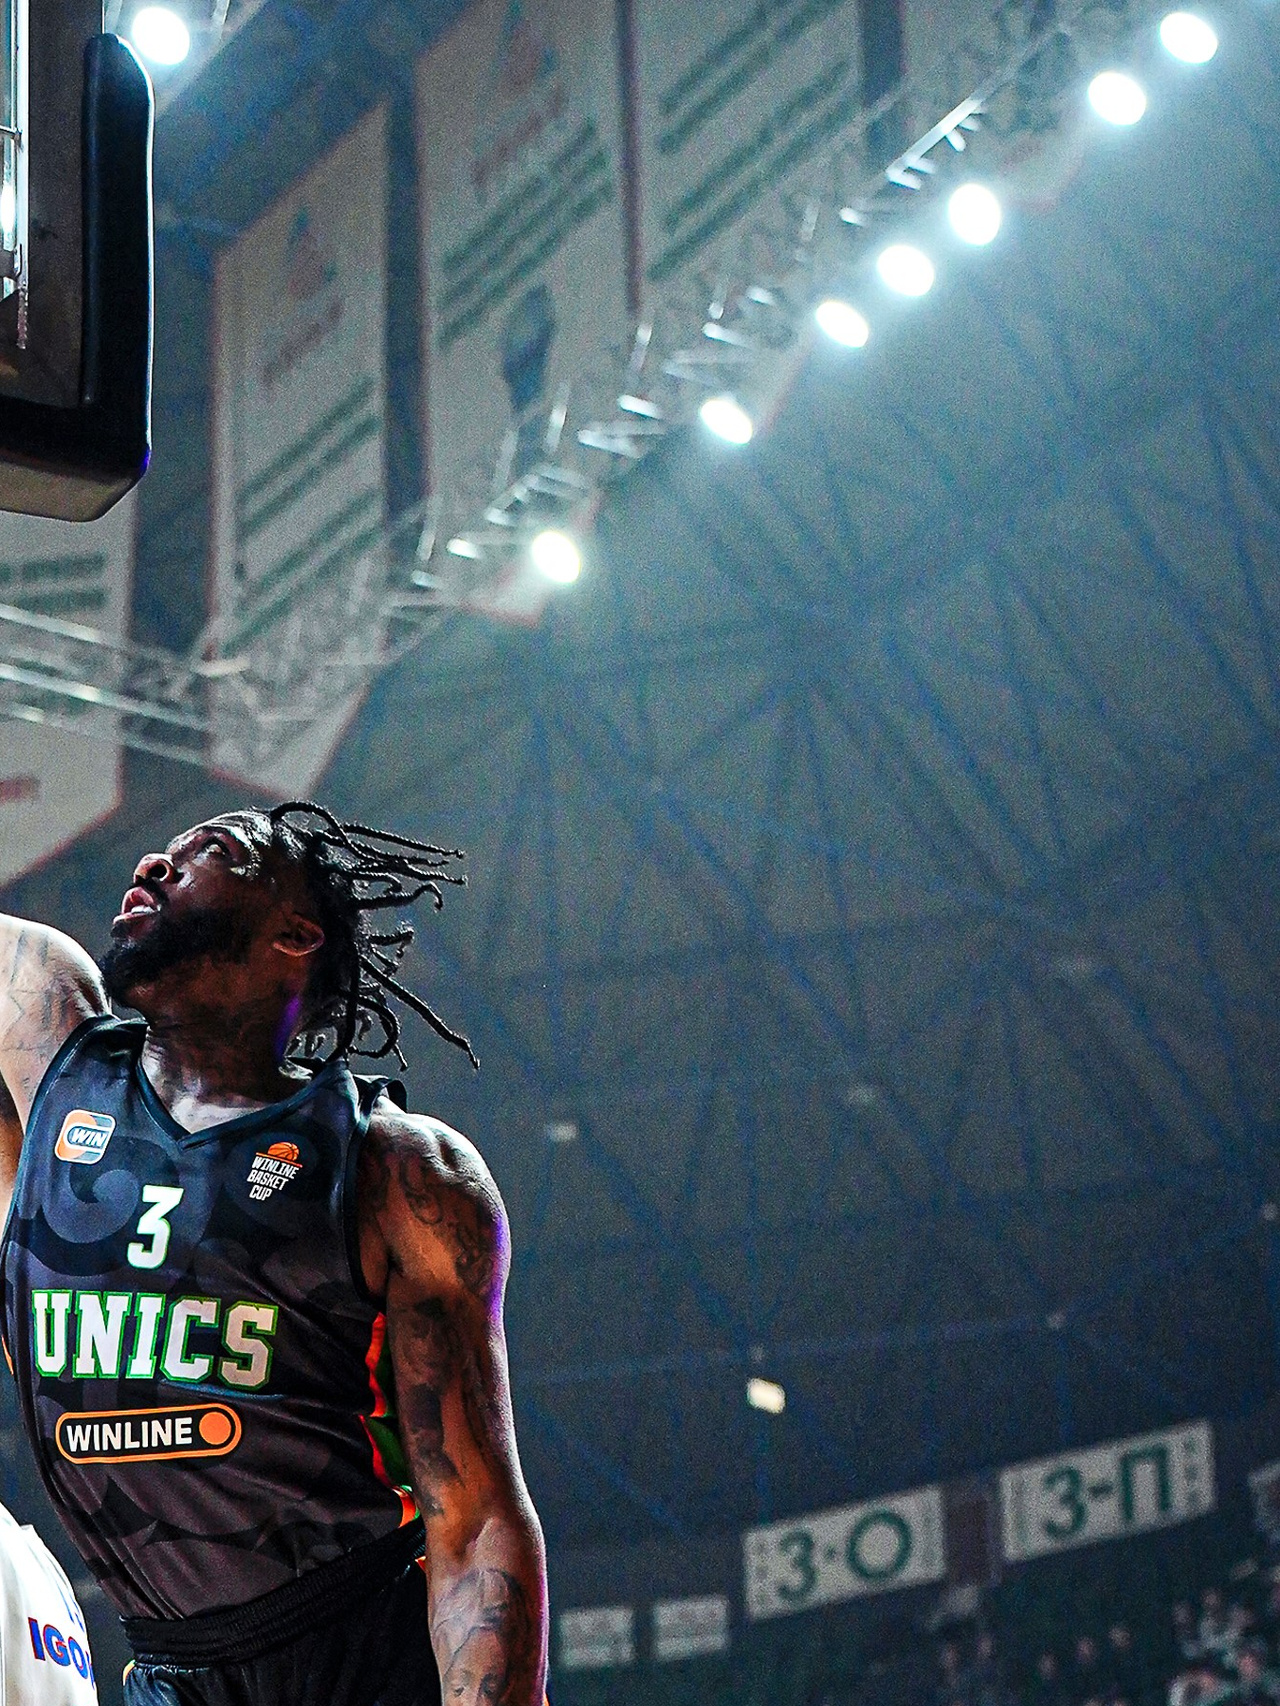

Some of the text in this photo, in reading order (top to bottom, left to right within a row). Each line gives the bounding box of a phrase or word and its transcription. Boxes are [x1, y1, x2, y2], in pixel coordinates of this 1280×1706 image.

[72, 1127, 107, 1148] WIN
[252, 1156, 300, 1179] WINLINE
[247, 1170, 288, 1191] BASKET
[249, 1184, 272, 1201] CUP
[127, 1184, 184, 1269] 3
[32, 1290, 279, 1391] UNICS
[67, 1417, 193, 1452] WINLINE
